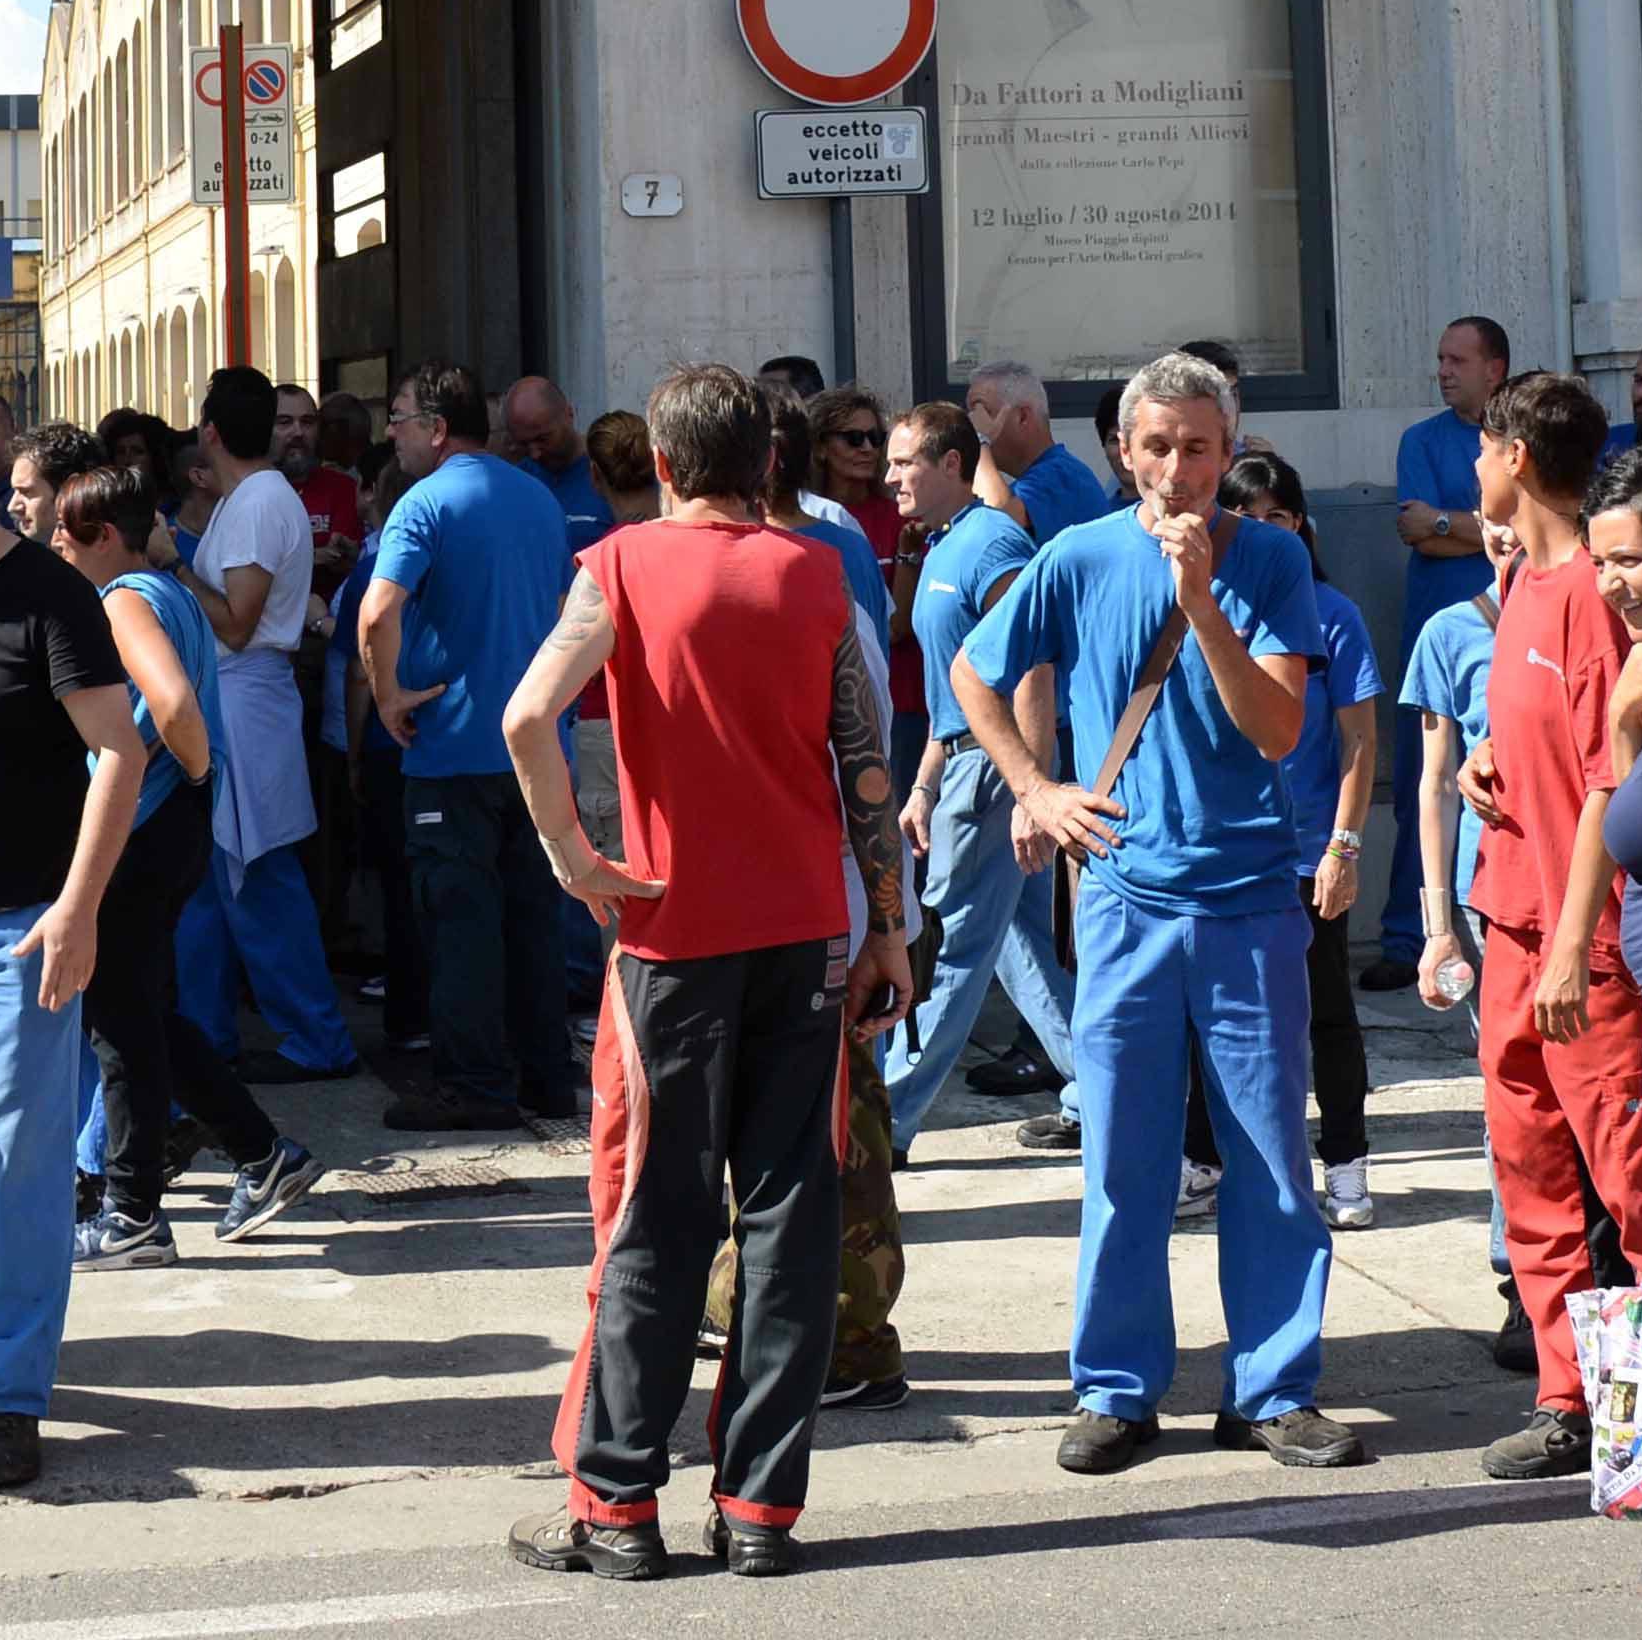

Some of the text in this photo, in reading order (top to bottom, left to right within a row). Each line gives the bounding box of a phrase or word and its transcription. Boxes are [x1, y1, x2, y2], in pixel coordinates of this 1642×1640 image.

[951, 80, 1245, 109] Da Fattori a Modigliani
[250, 132, 279, 145] 0-24
[802, 120, 883, 138] eccetto
[950, 129, 1015, 149] grandi
[1024, 127, 1095, 144] Maestri
[1117, 126, 1179, 147] grandi
[808, 143, 879, 161] veicoli
[787, 165, 902, 185] autorizzati
[644, 180, 660, 209] 7
[972, 208, 995, 227] 12
[1003, 206, 1063, 232] luglio
[1083, 206, 1108, 225] 30
[1114, 205, 1181, 228] agosto
[1187, 202, 1238, 221] 2014
